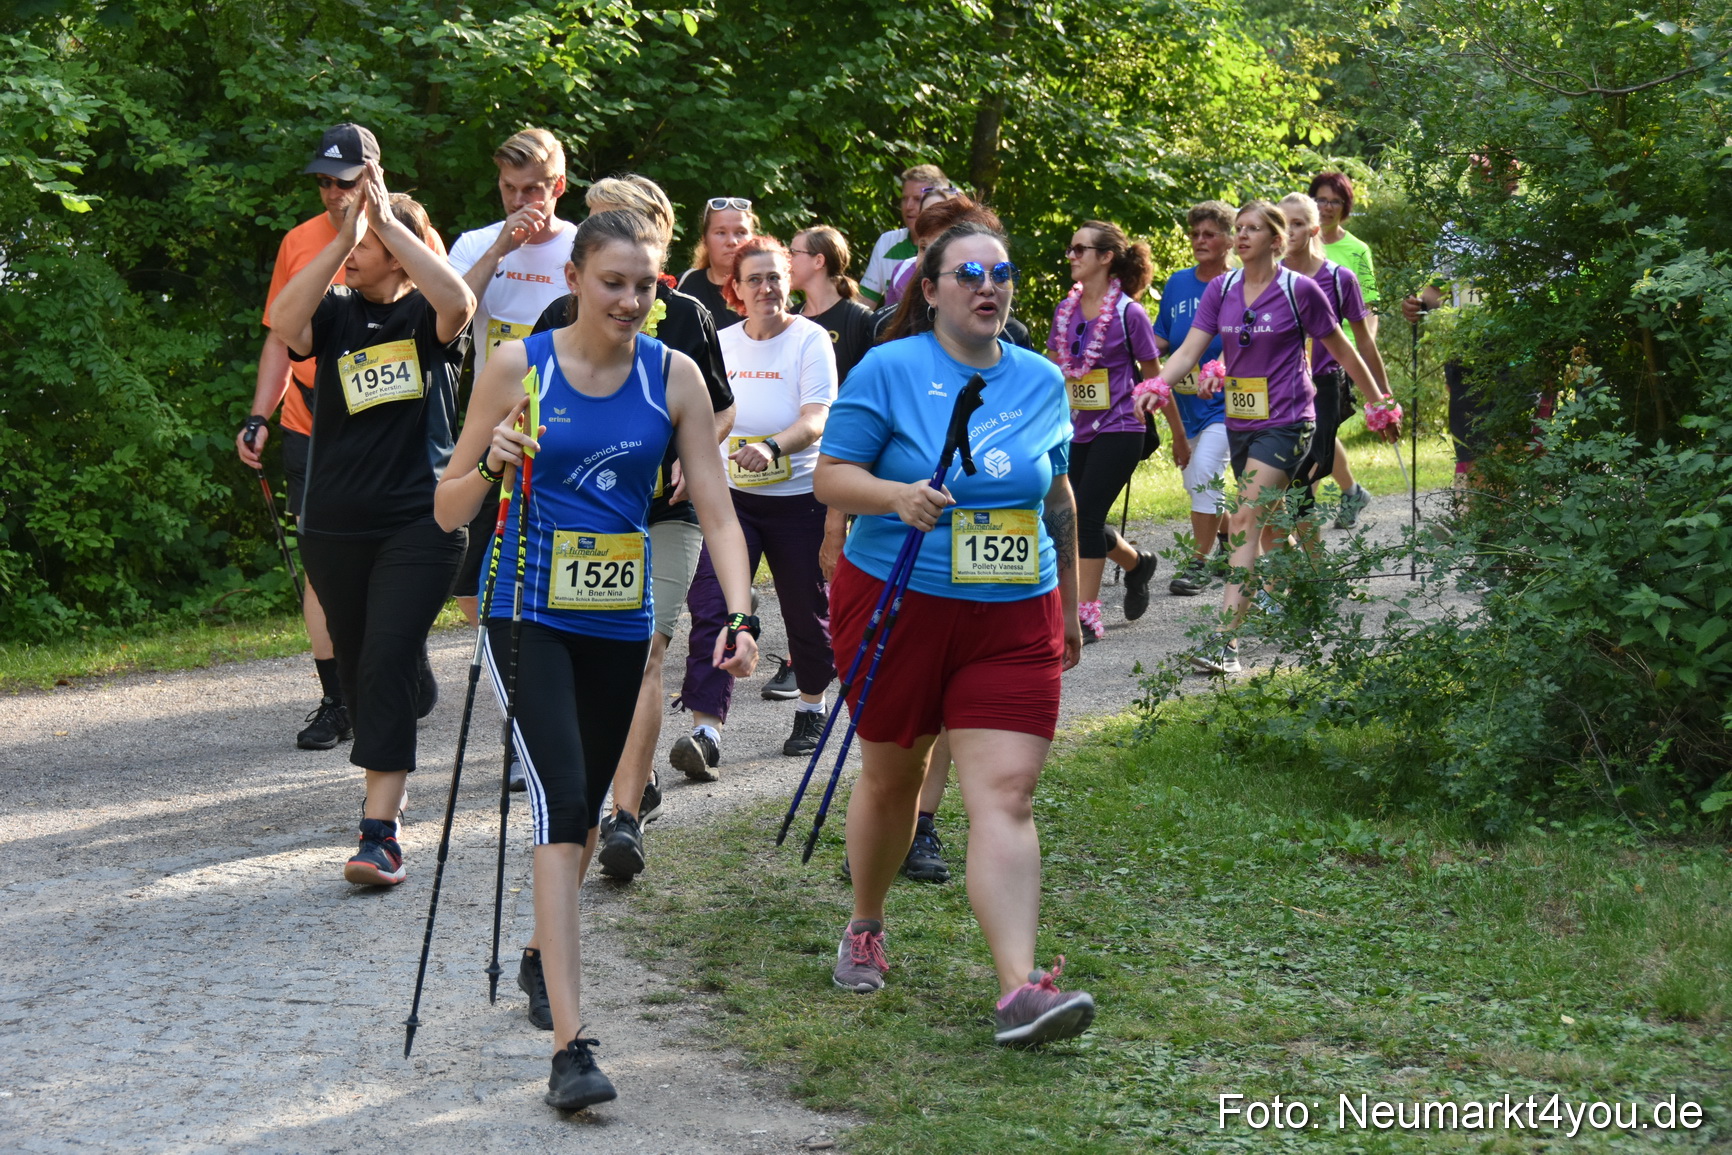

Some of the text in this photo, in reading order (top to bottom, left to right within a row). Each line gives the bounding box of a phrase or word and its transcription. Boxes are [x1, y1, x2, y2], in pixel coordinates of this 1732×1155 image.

[506, 271, 554, 284] KLEBL
[351, 361, 411, 393] 1954
[739, 371, 783, 379] KLEBL
[365, 384, 402, 397] Beer Kerstin
[1072, 384, 1096, 399] 886
[1232, 392, 1255, 407] 880
[999, 409, 1023, 422] Bau
[562, 440, 642, 485] Team Schick Bau
[517, 535, 527, 576] LEKI
[569, 547, 610, 557] firmenlauf
[965, 535, 1029, 562] 1529
[490, 536, 503, 577] LEKI
[565, 561, 635, 588] 1526
[972, 563, 997, 571] Pollety
